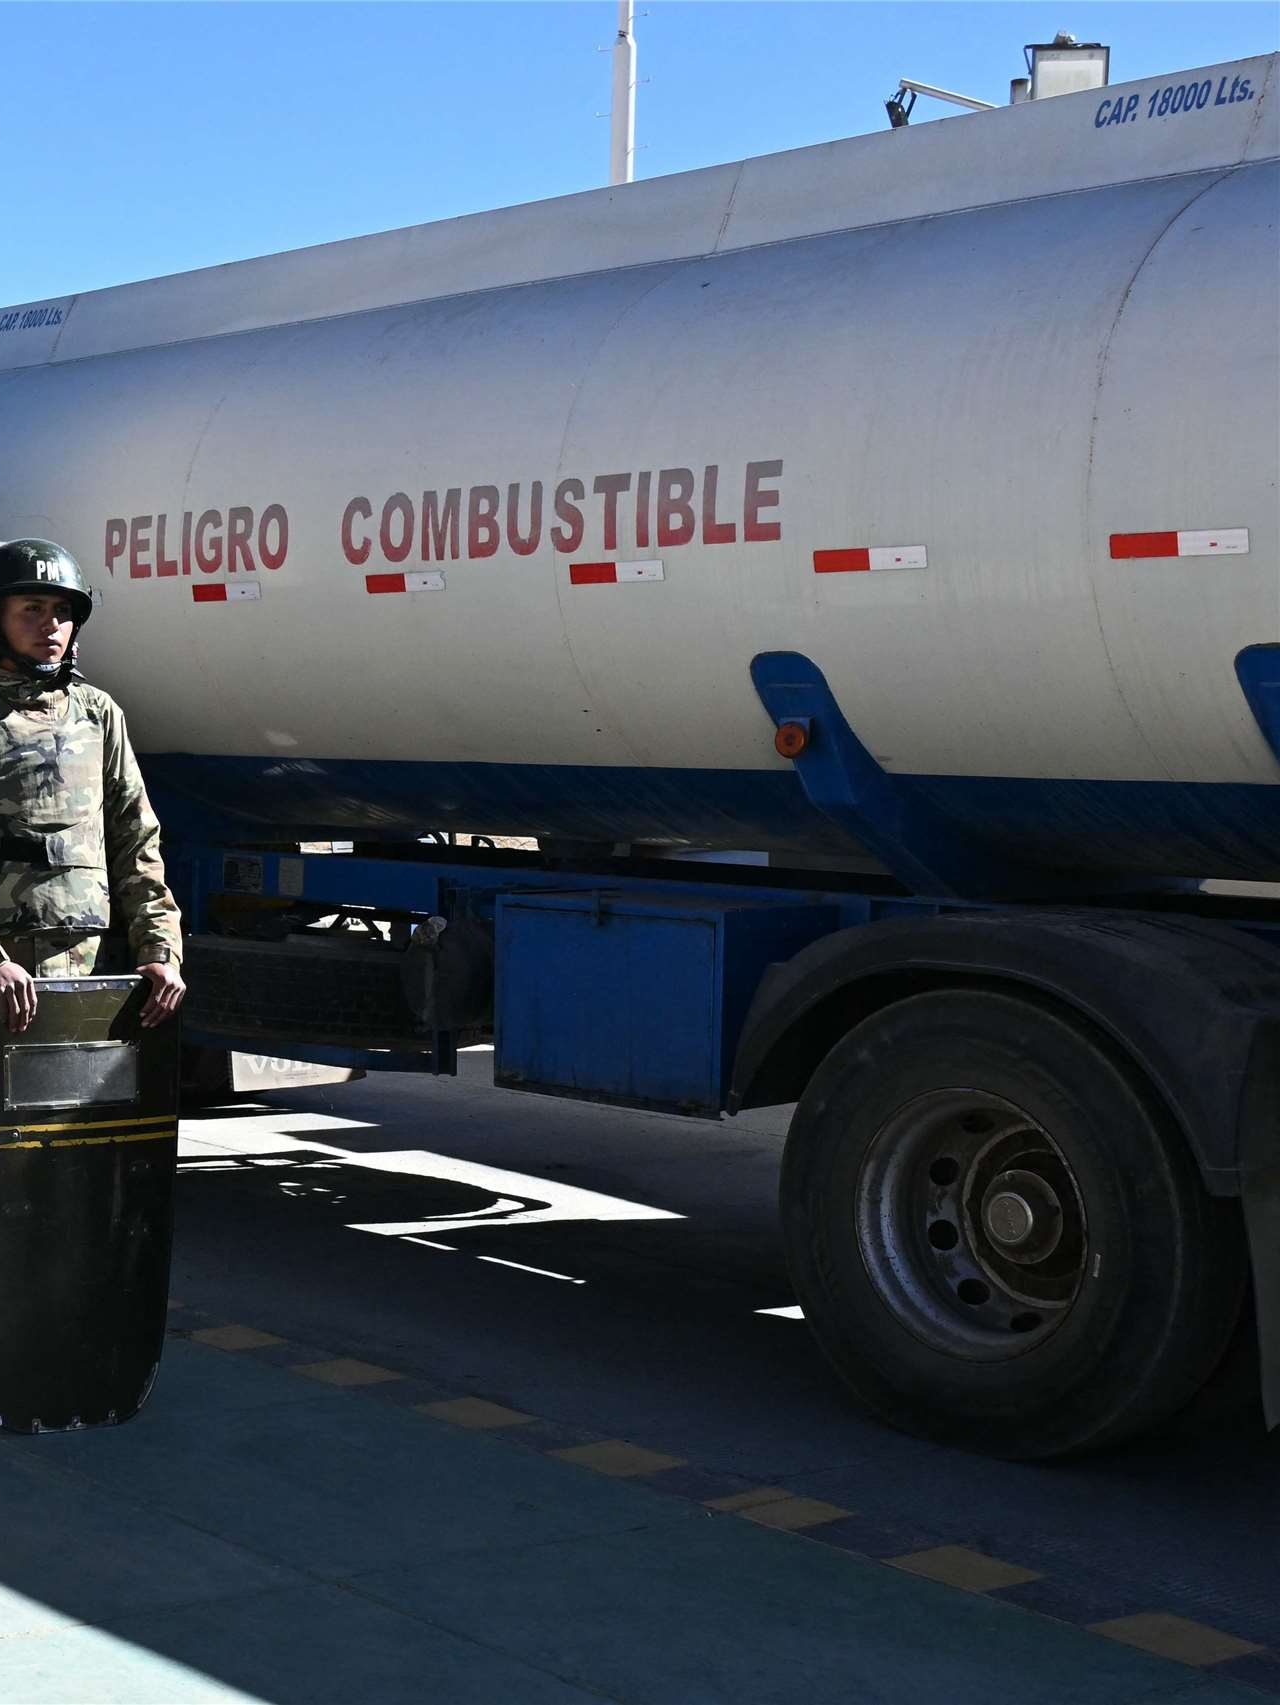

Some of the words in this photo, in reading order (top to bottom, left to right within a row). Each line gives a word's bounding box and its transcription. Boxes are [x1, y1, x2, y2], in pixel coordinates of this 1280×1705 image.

[1094, 94, 1140, 128] CAP.
[1148, 79, 1212, 118] 18000
[1214, 75, 1255, 106] Lts.
[105, 503, 289, 579] PELIGRO
[341, 459, 784, 565] COMBUSTIBLE
[36, 560, 61, 582] PM
